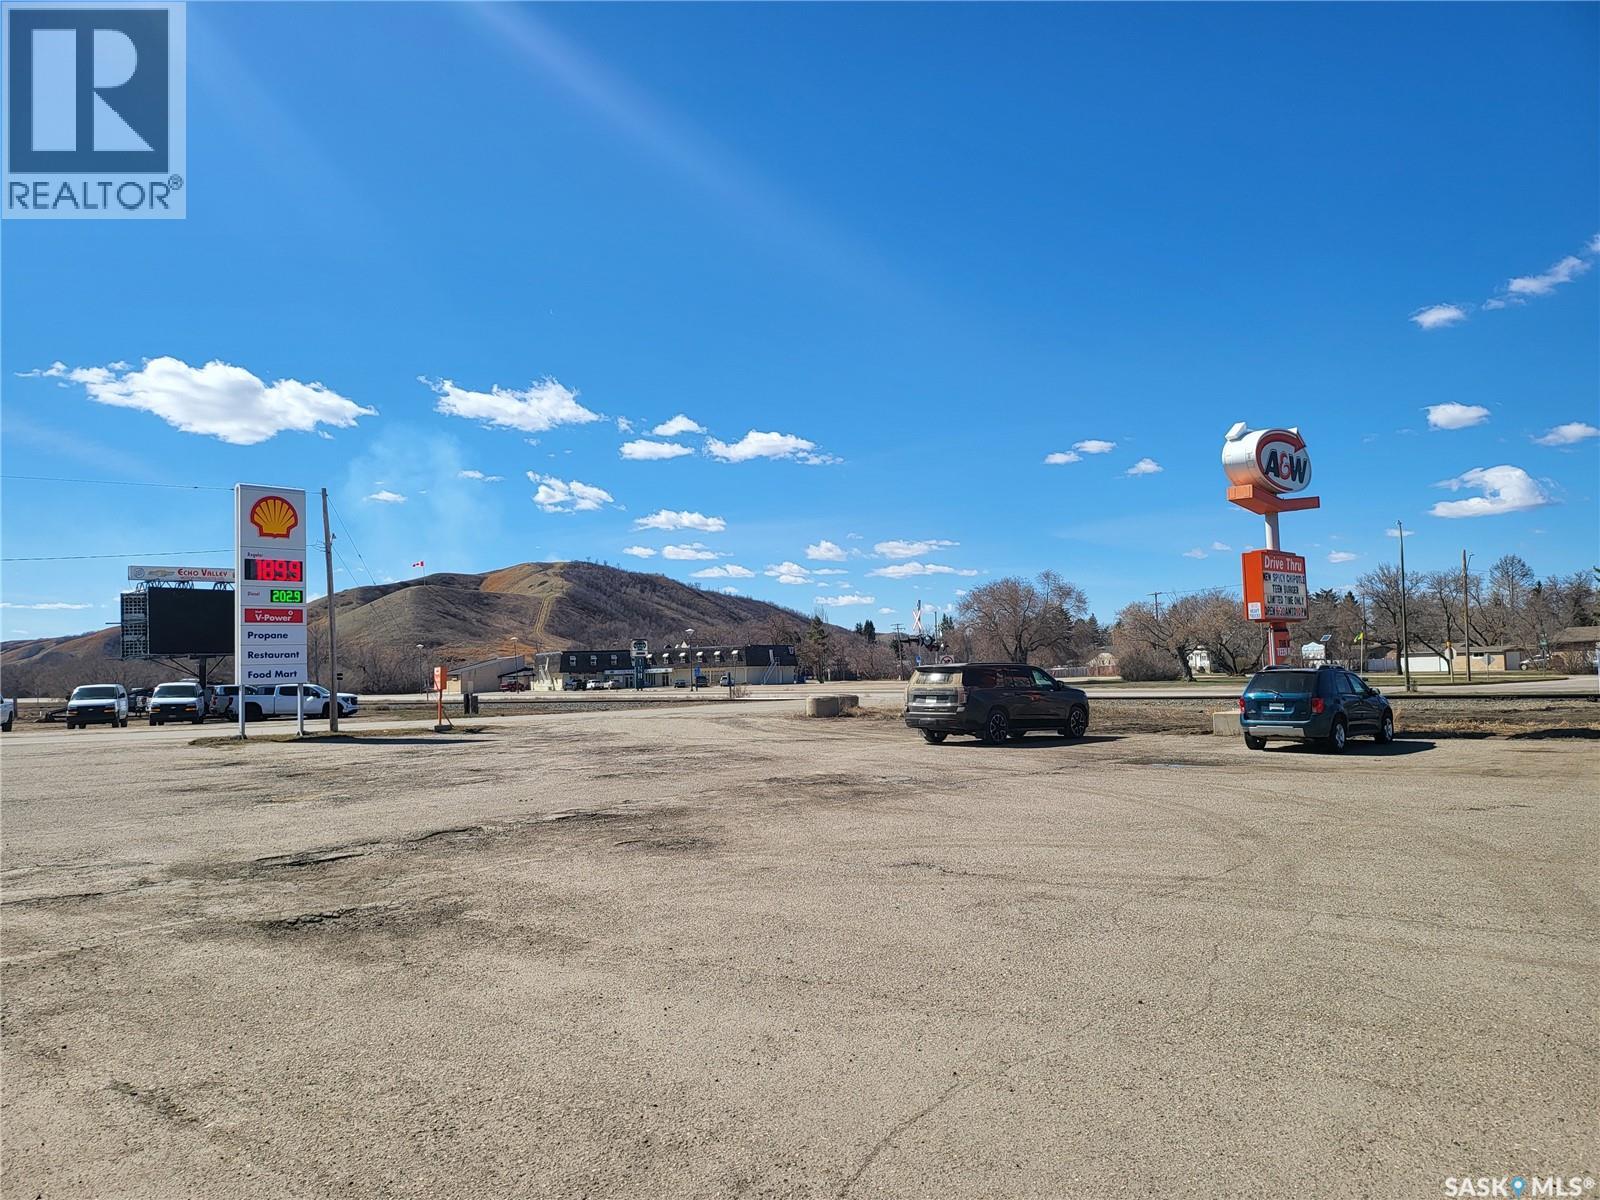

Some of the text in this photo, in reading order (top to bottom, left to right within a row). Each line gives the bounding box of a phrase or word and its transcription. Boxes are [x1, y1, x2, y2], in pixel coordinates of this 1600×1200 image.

[1265, 448, 1307, 484] A&W
[1264, 555, 1302, 572] Drive Thru
[255, 614, 292, 622] V-Power
[247, 631, 289, 641] Propane
[247, 651, 300, 659] Restaurant
[247, 670, 297, 679] Food Mart
